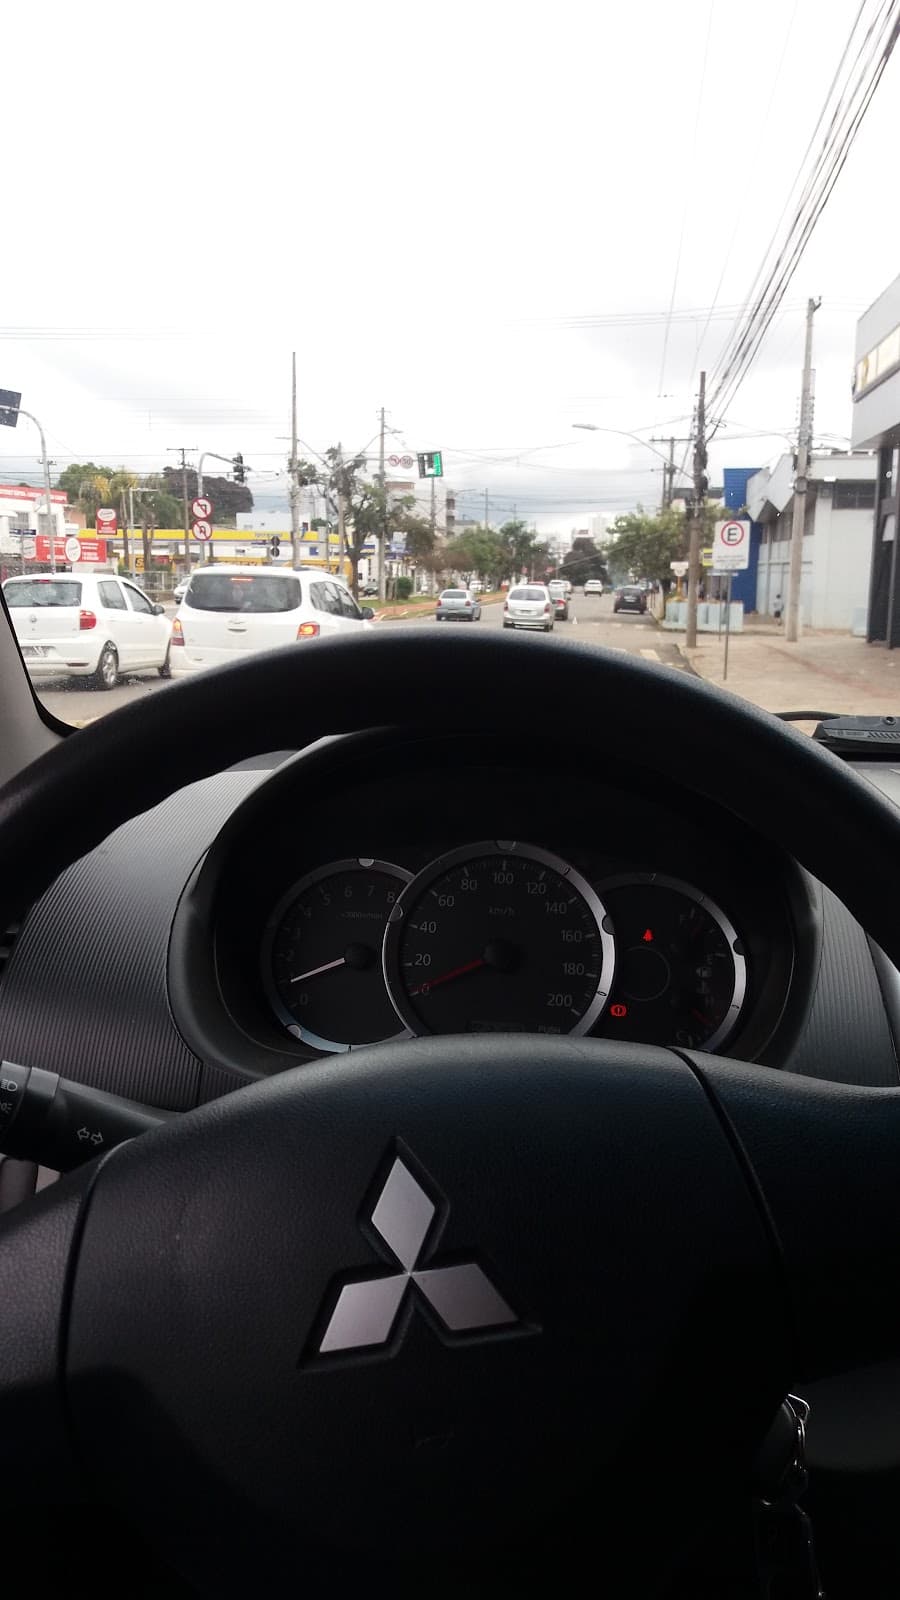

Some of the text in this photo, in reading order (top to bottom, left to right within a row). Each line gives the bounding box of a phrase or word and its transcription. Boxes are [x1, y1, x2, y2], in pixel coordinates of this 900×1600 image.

[727, 527, 738, 542] E
[493, 872, 514, 884] 100
[461, 879, 477, 890] 80
[527, 882, 546, 894] 120
[344, 886, 353, 898] 6
[368, 885, 376, 897] 7
[387, 891, 395, 903] 8
[322, 894, 331, 905] 5
[438, 895, 455, 907] 60
[545, 902, 567, 914] 140
[419, 921, 436, 933] 40
[561, 930, 582, 942] 160
[415, 953, 431, 966] 20
[562, 963, 584, 975] 180
[299, 993, 308, 1005] 0
[546, 994, 572, 1007] 200
